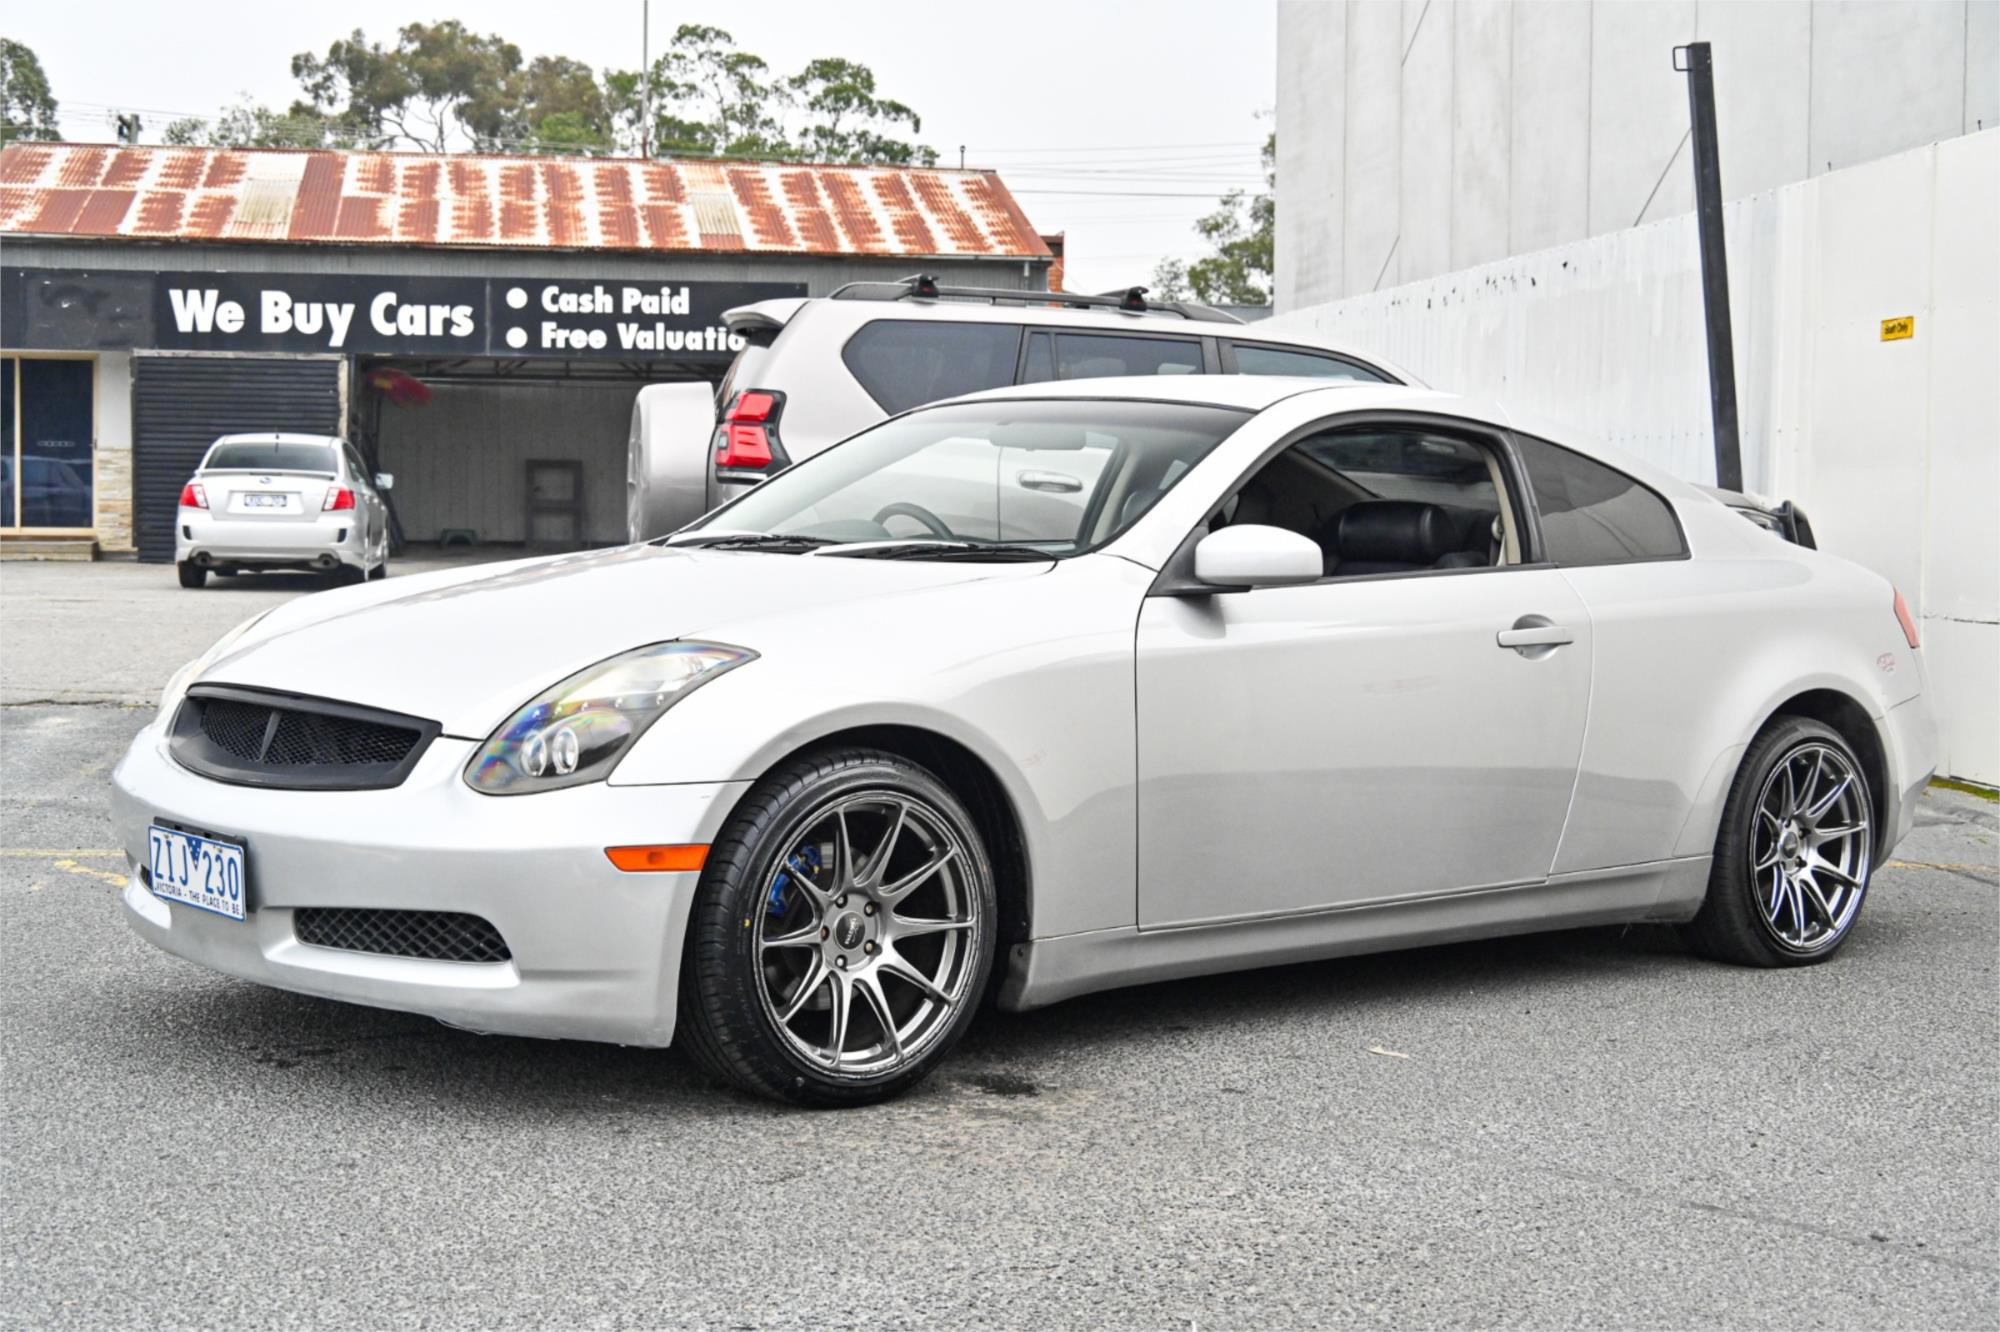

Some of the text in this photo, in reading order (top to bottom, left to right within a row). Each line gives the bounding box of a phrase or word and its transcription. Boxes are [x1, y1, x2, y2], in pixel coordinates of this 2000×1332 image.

[541, 286, 690, 315] Cash Paid
[169, 289, 475, 347] We Buy Cars
[541, 321, 747, 352] Free Valuatio
[203, 851, 239, 900] 230
[188, 889, 200, 903] THE
[202, 893, 221, 909] PLACE
[221, 898, 230, 912] TO
[231, 902, 240, 915] BE
